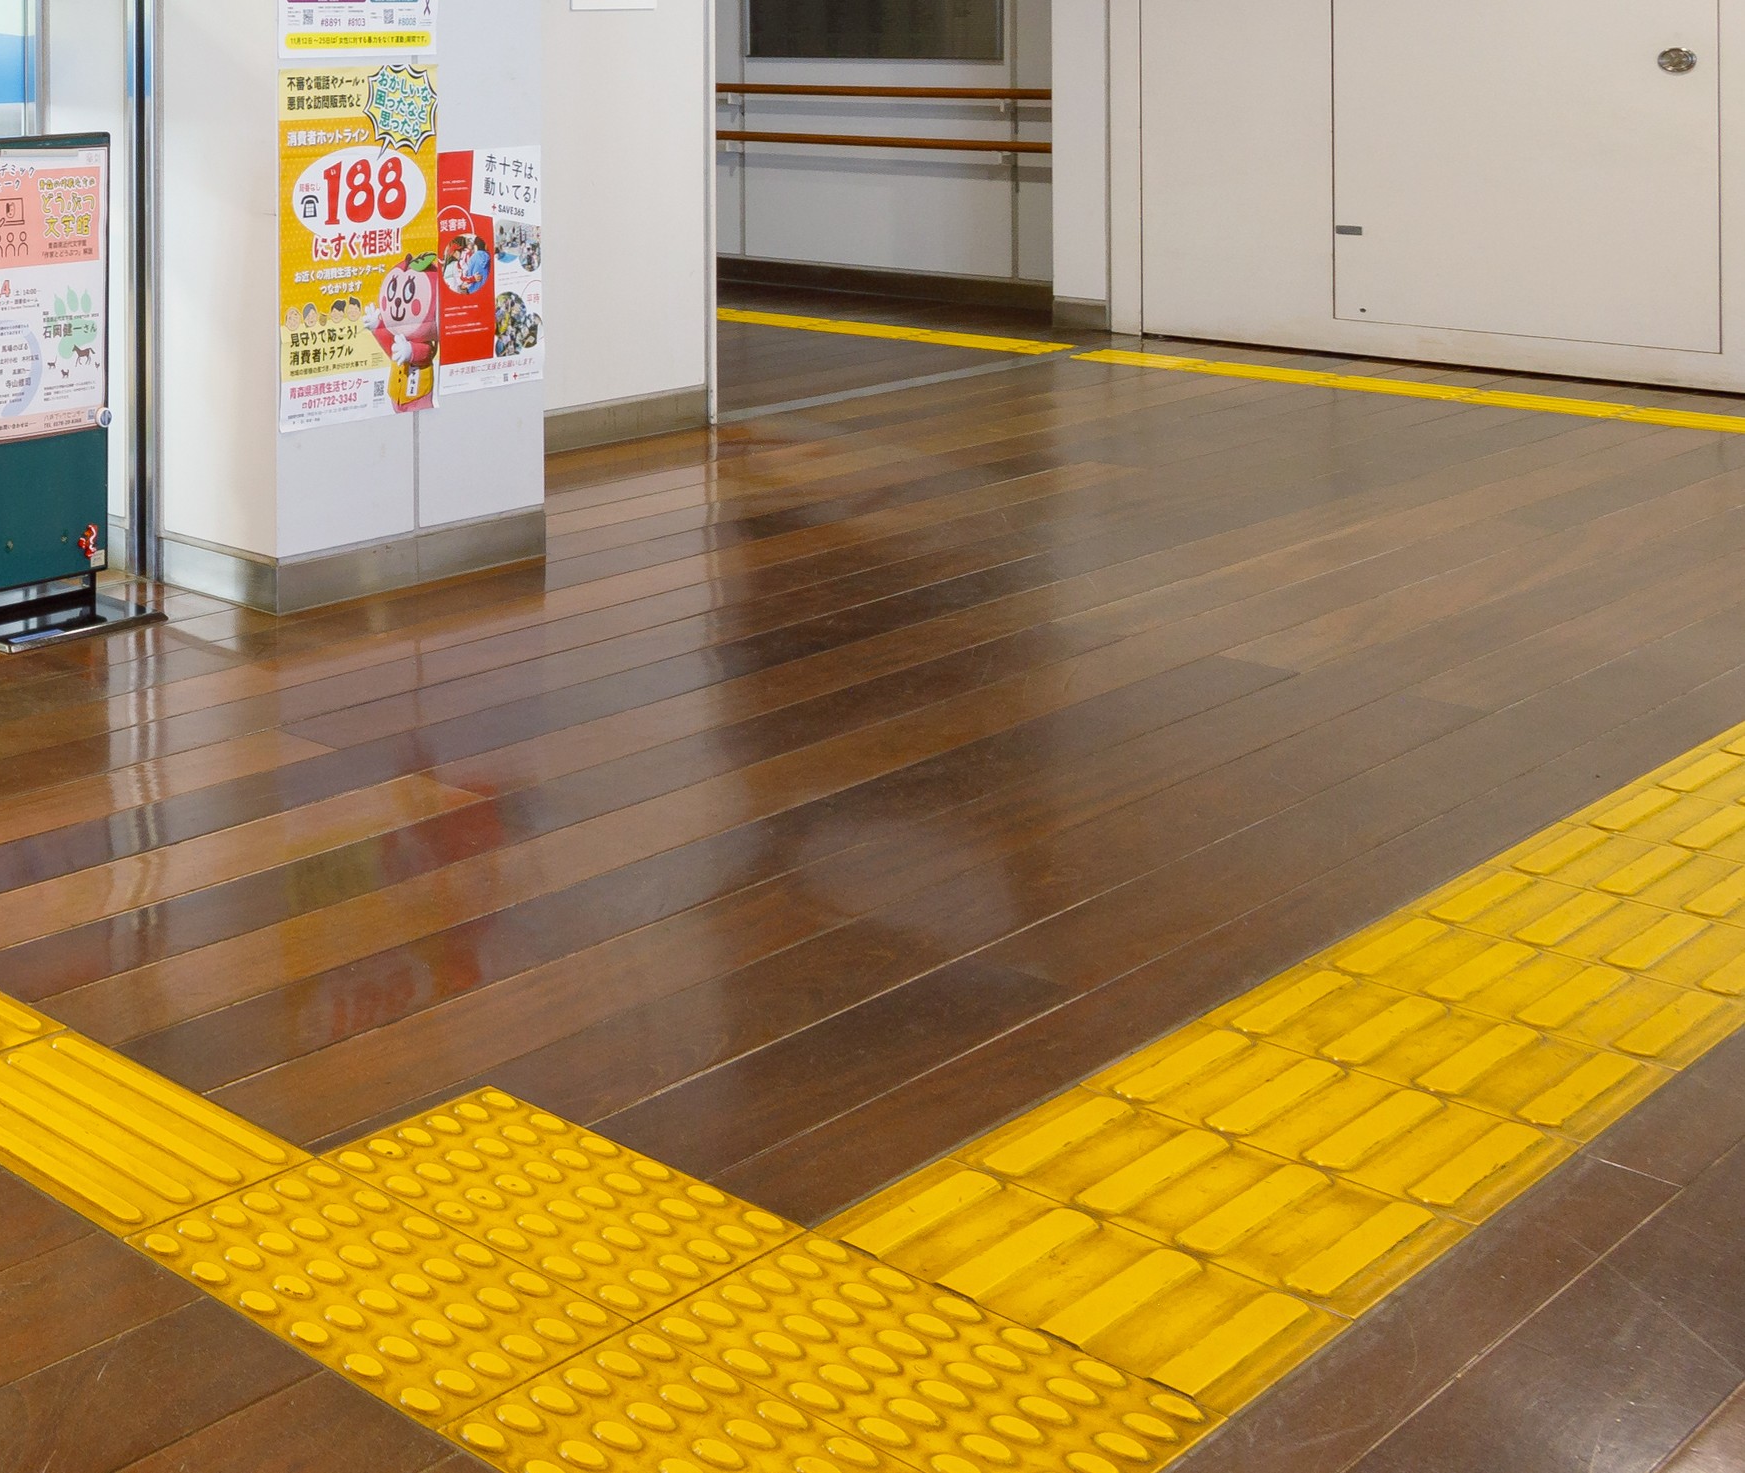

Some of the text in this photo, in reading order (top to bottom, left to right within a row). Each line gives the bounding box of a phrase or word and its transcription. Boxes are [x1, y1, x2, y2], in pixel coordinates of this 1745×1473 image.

[377, 71, 432, 104] おかしいな
[286, 94, 362, 111] 悪質な訪問販売など
[374, 88, 428, 122] 困ったなと
[378, 110, 422, 140] 思ったら
[287, 128, 370, 147] 消費者ホットライン
[484, 153, 540, 183] 赤十字は、
[322, 156, 407, 226] 188
[483, 176, 538, 204] 動いてる！
[41, 192, 96, 214] どうぶつ
[498, 204, 525, 218] SAVE365
[43, 213, 92, 238] 文学館
[439, 218, 468, 233] 災害時
[313, 227, 402, 260] にすぐ相談！
[294, 263, 387, 284] お近くの消費生活センターに
[320, 280, 364, 296] つながります
[289, 343, 354, 367] 消費者トラブル
[289, 377, 370, 401] 青森県消費生活センター
